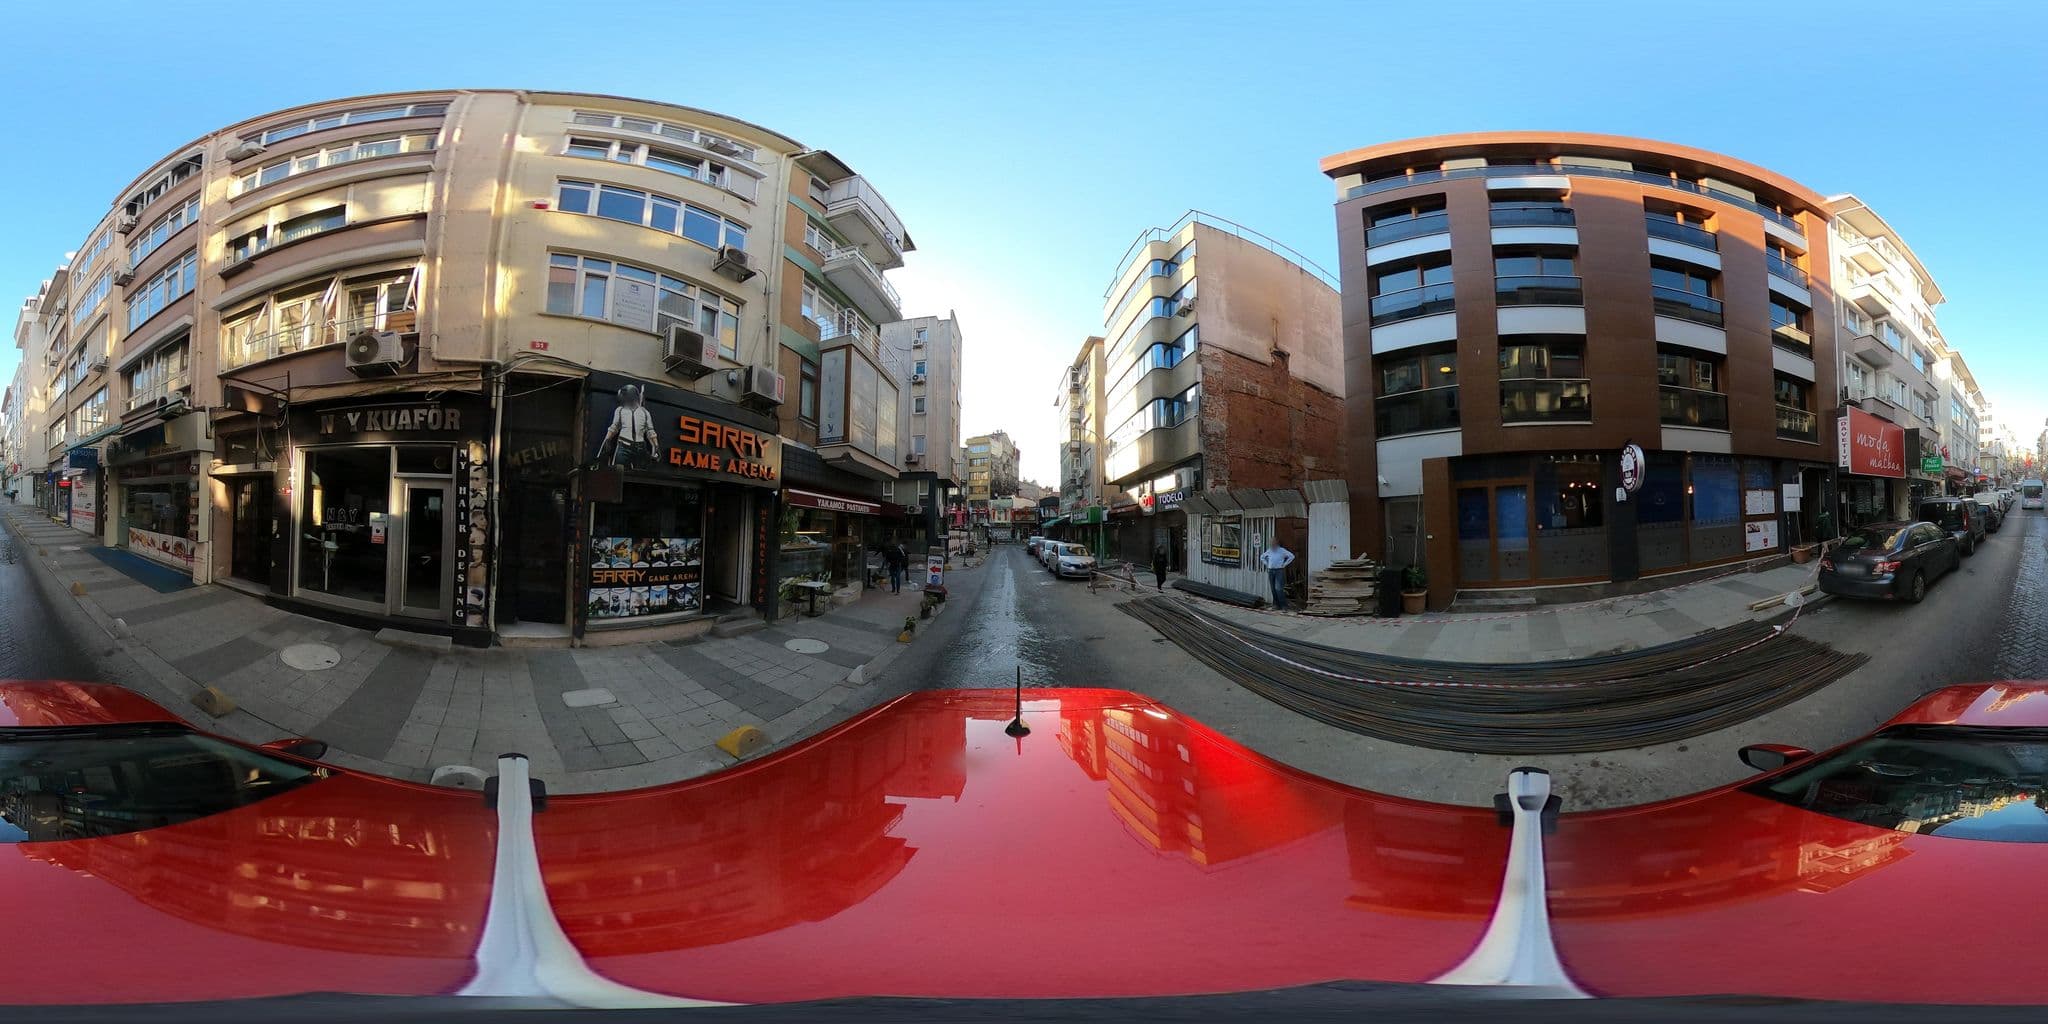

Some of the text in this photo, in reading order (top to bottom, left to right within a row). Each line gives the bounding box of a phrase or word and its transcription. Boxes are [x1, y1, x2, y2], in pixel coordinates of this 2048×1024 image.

[366, 405, 461, 432] KUAFÖR
[680, 415, 769, 459] SARAY
[670, 447, 777, 481] GAME ARENA
[458, 486, 467, 533] HAIR
[816, 498, 845, 510] YAKAMOZ
[455, 550, 467, 617] DESING
[592, 570, 699, 585] SARAY GAME ARENA
